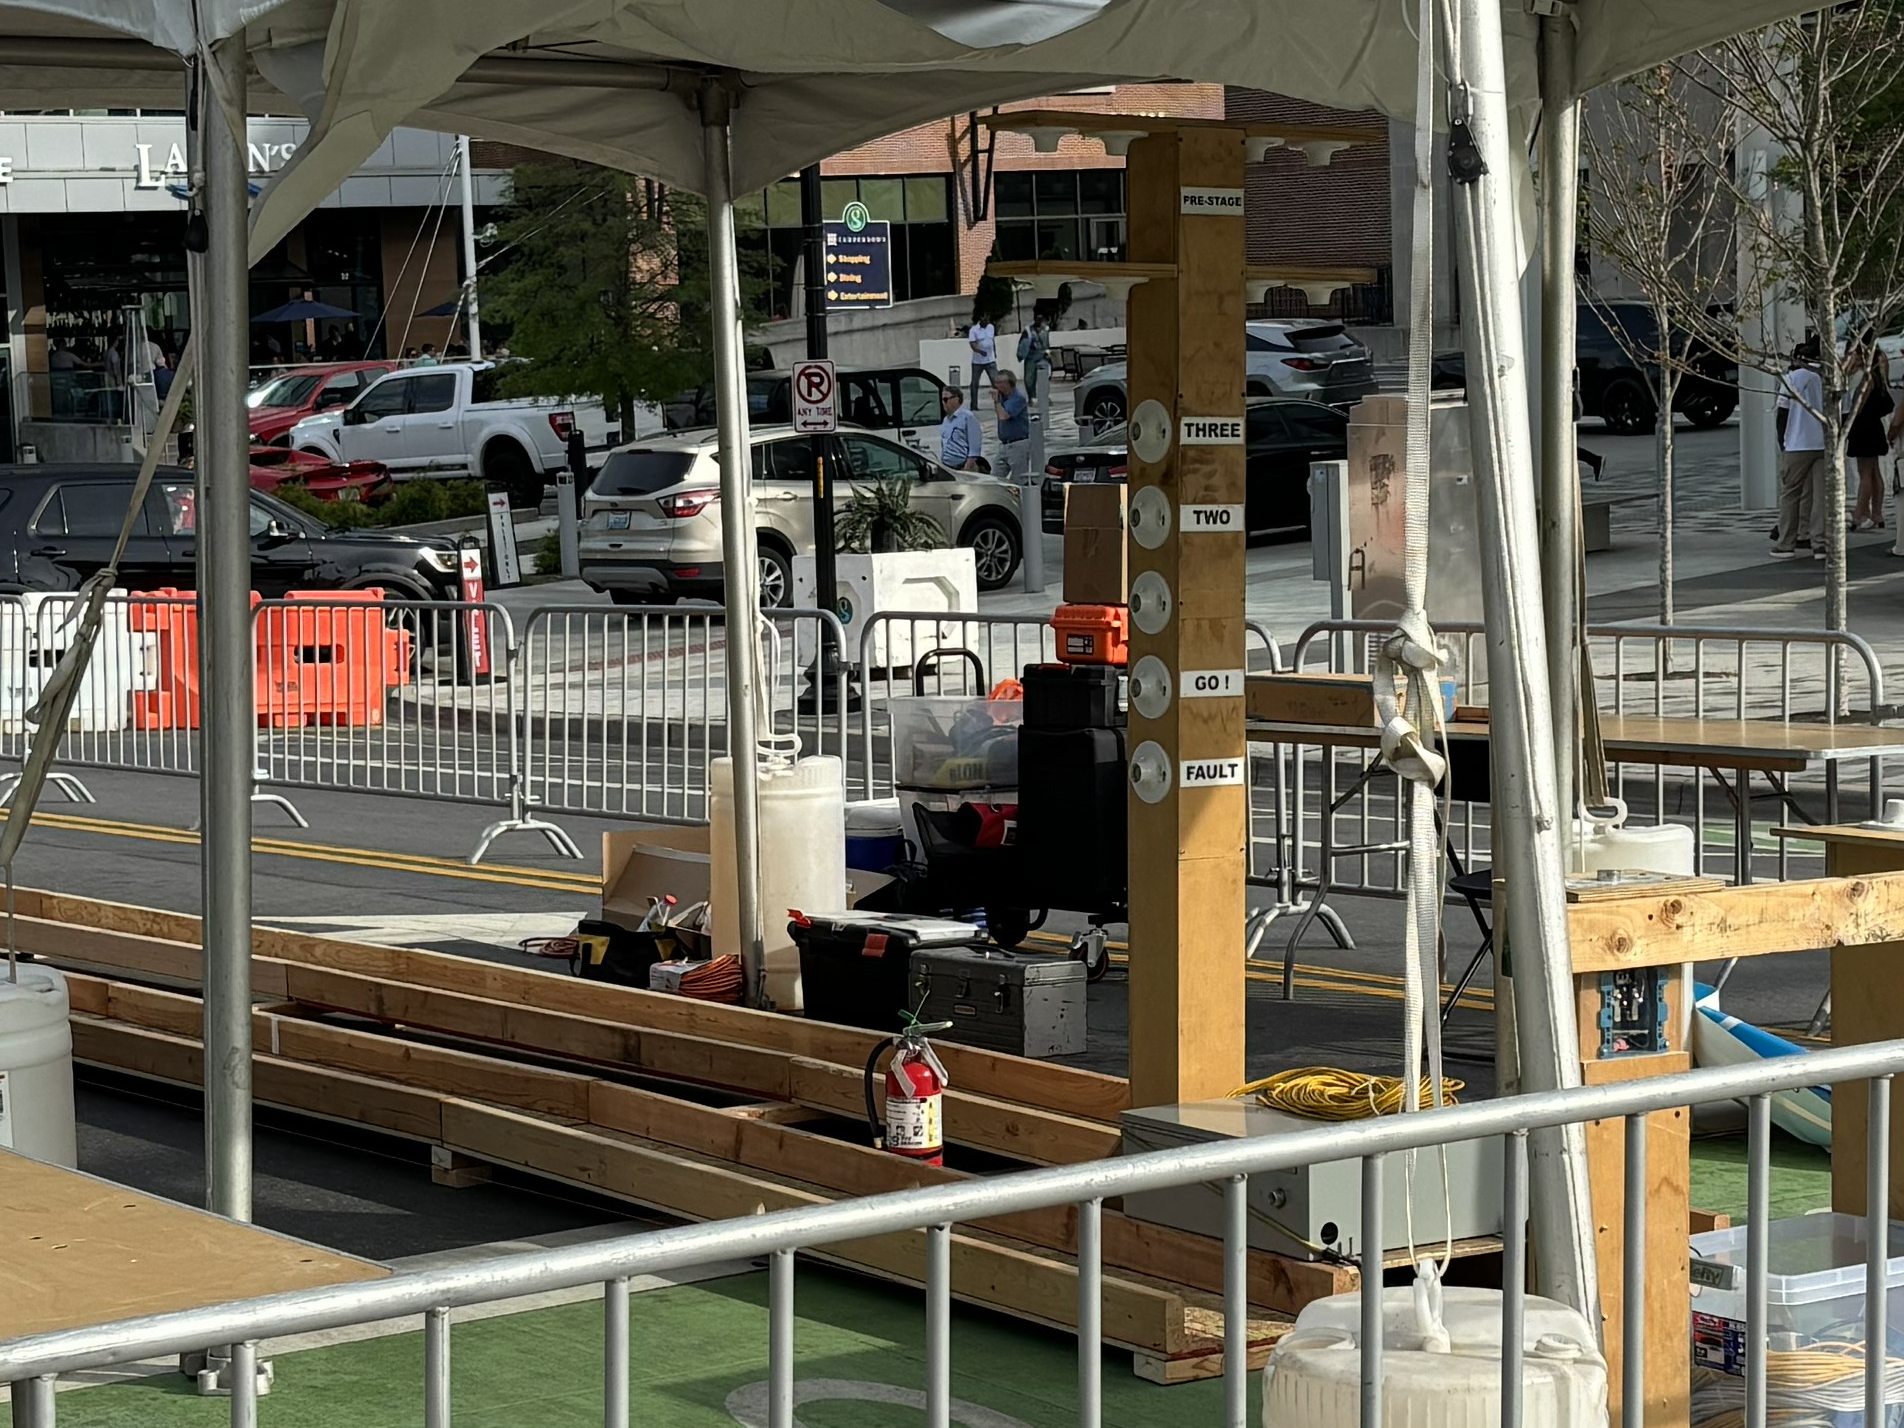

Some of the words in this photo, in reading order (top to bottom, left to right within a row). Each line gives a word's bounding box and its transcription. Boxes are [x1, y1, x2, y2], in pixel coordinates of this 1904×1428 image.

[1183, 195, 1242, 207] PRE-STAGE
[798, 406, 812, 416] ANY
[816, 406, 833, 416] TIME
[1184, 422, 1242, 438] THREE
[1192, 509, 1231, 525] TWO
[1195, 675, 1219, 690] GO
[1186, 763, 1239, 781] FAULT
